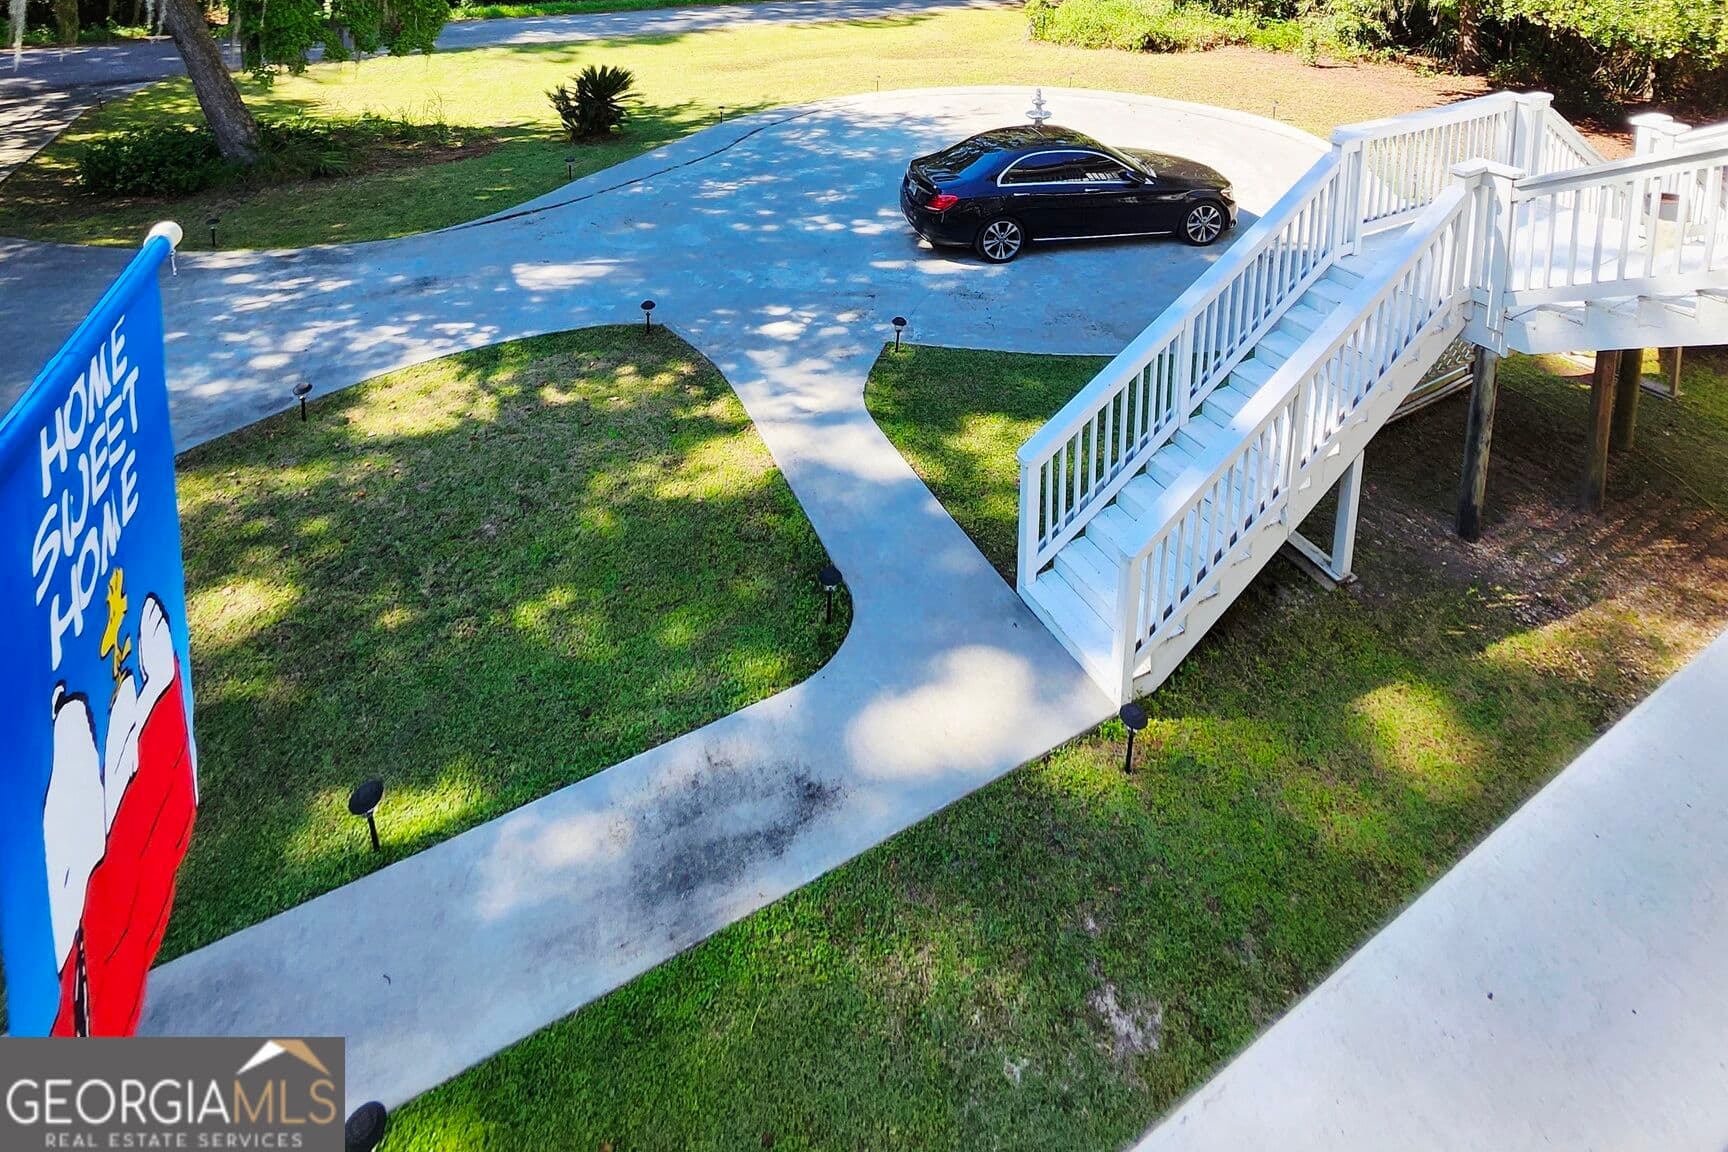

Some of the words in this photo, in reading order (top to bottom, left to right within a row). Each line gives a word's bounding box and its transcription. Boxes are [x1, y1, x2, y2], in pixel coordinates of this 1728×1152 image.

[32, 366, 139, 606] SWEET
[41, 314, 128, 498] HOME
[51, 449, 139, 671] HOME
